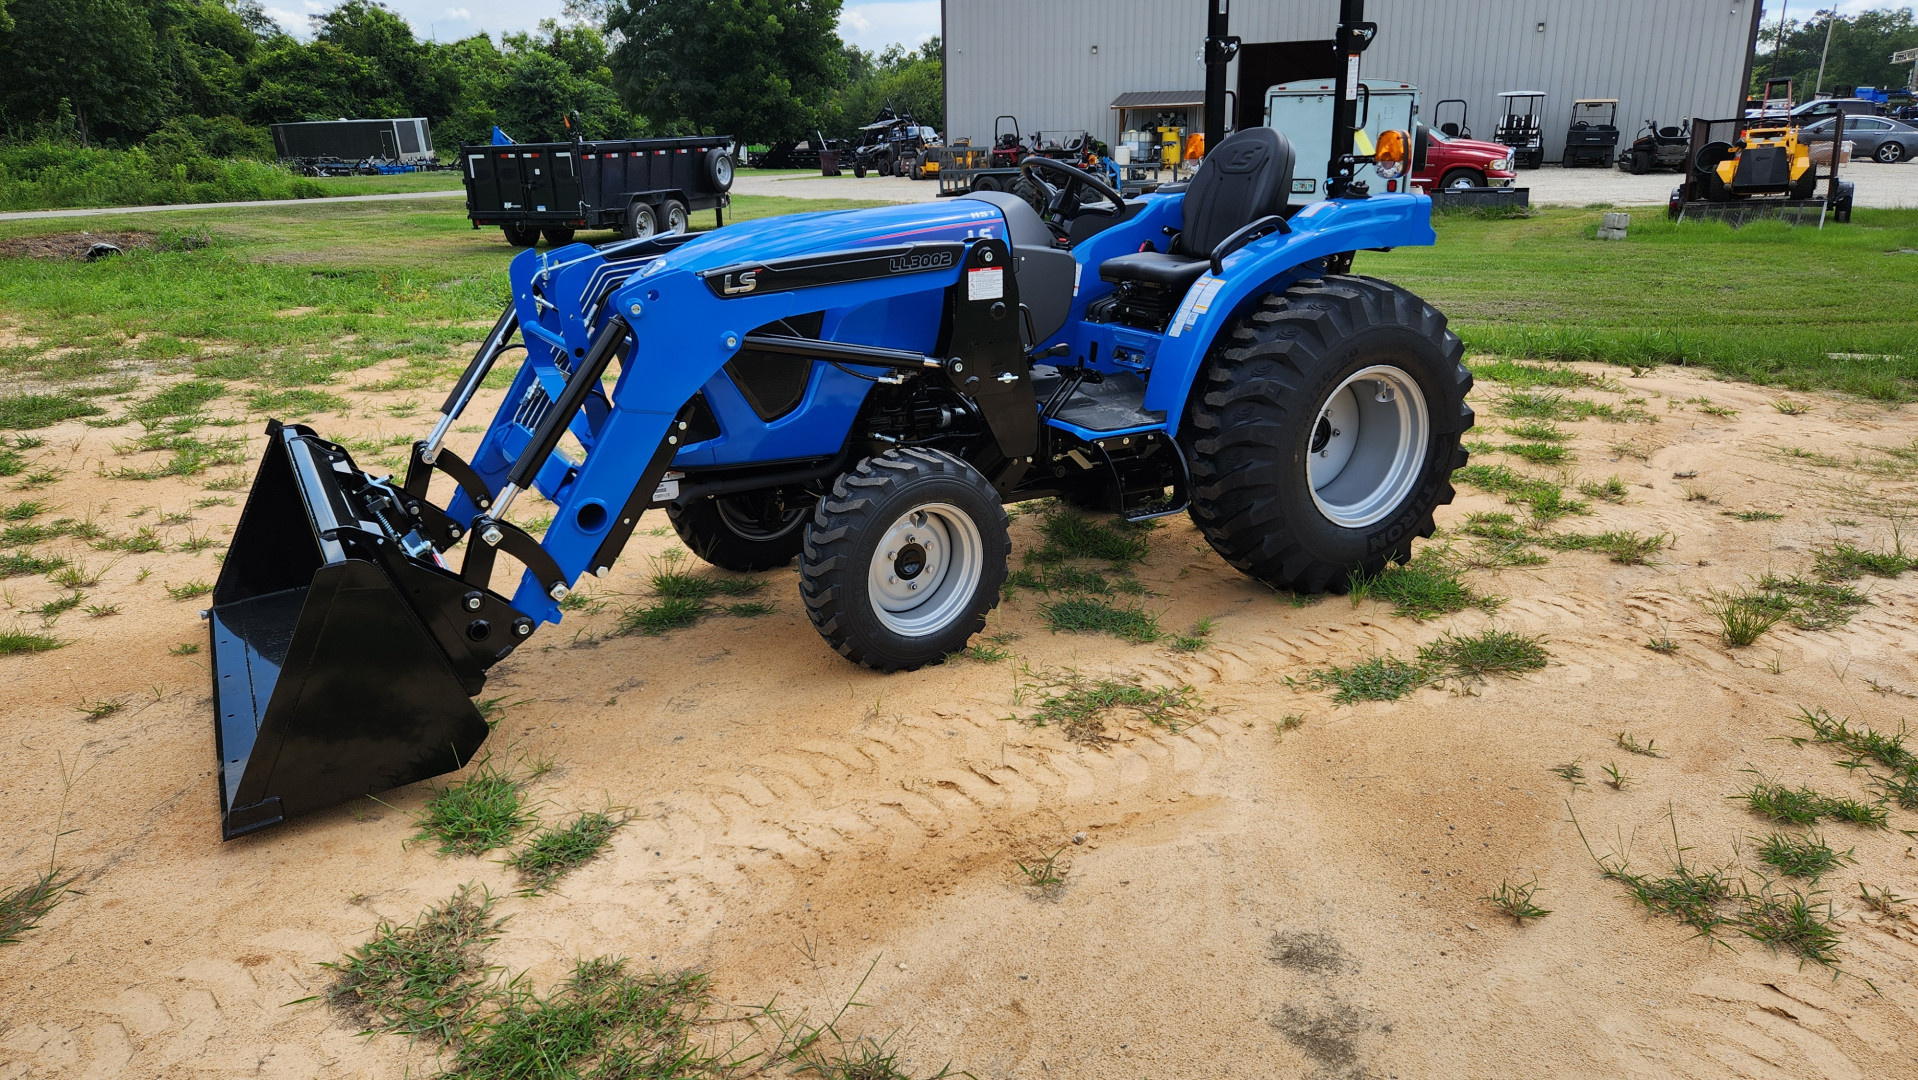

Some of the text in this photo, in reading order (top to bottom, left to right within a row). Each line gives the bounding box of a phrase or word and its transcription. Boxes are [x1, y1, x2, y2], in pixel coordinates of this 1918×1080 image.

[971, 210, 996, 218] HST
[889, 252, 952, 272] LL3002
[724, 271, 757, 294] LS
[1370, 484, 1437, 551] TIRON
